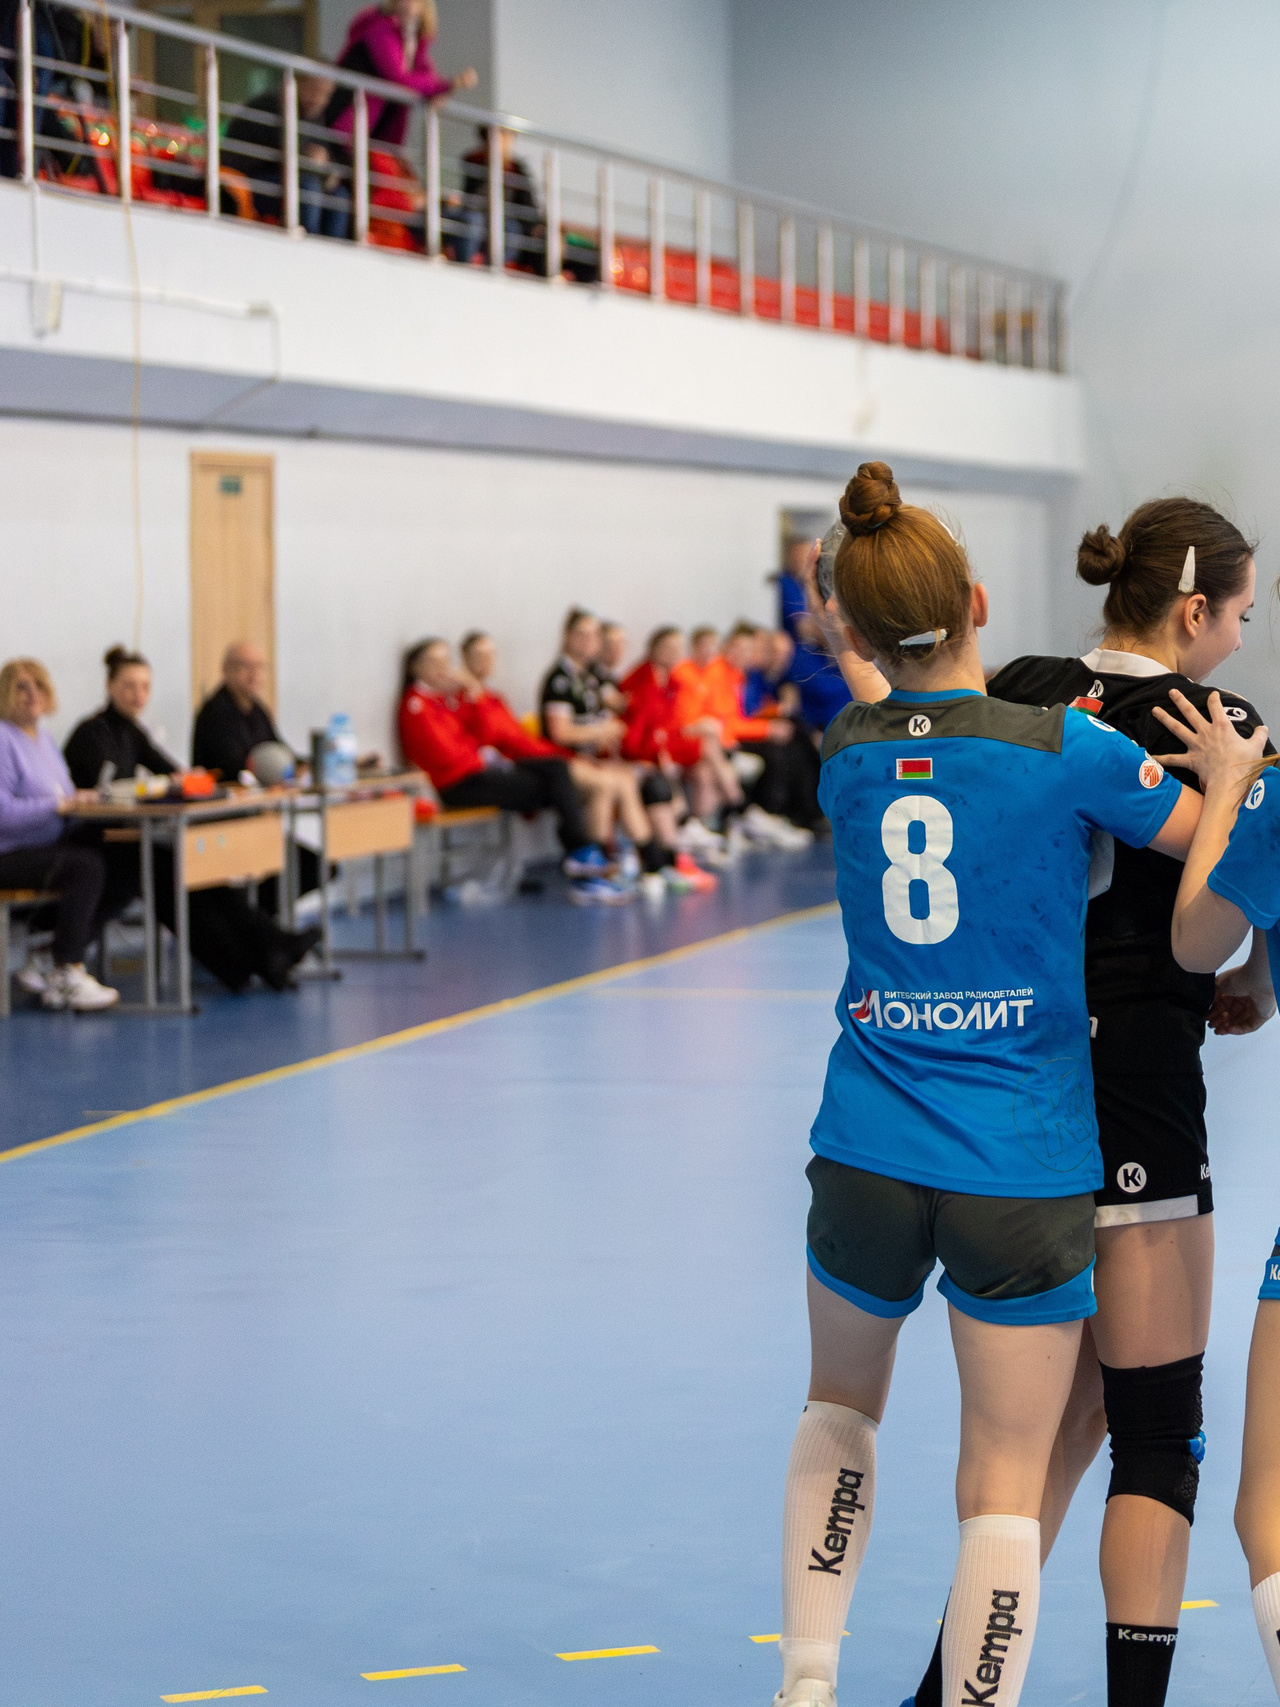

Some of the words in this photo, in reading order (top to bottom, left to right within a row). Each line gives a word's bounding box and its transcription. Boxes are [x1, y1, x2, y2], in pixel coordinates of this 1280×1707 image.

[881, 795, 959, 945] 8
[884, 990, 931, 1000] ВИТЕБСКИЙ
[933, 991, 963, 1000] ЗАВОД
[965, 987, 1033, 999] РАДИОДЕТАЛЕЙ
[808, 1467, 865, 1576] Kempa
[961, 1589, 1023, 1707] Kempa
[1118, 1628, 1177, 1646] Kemp
